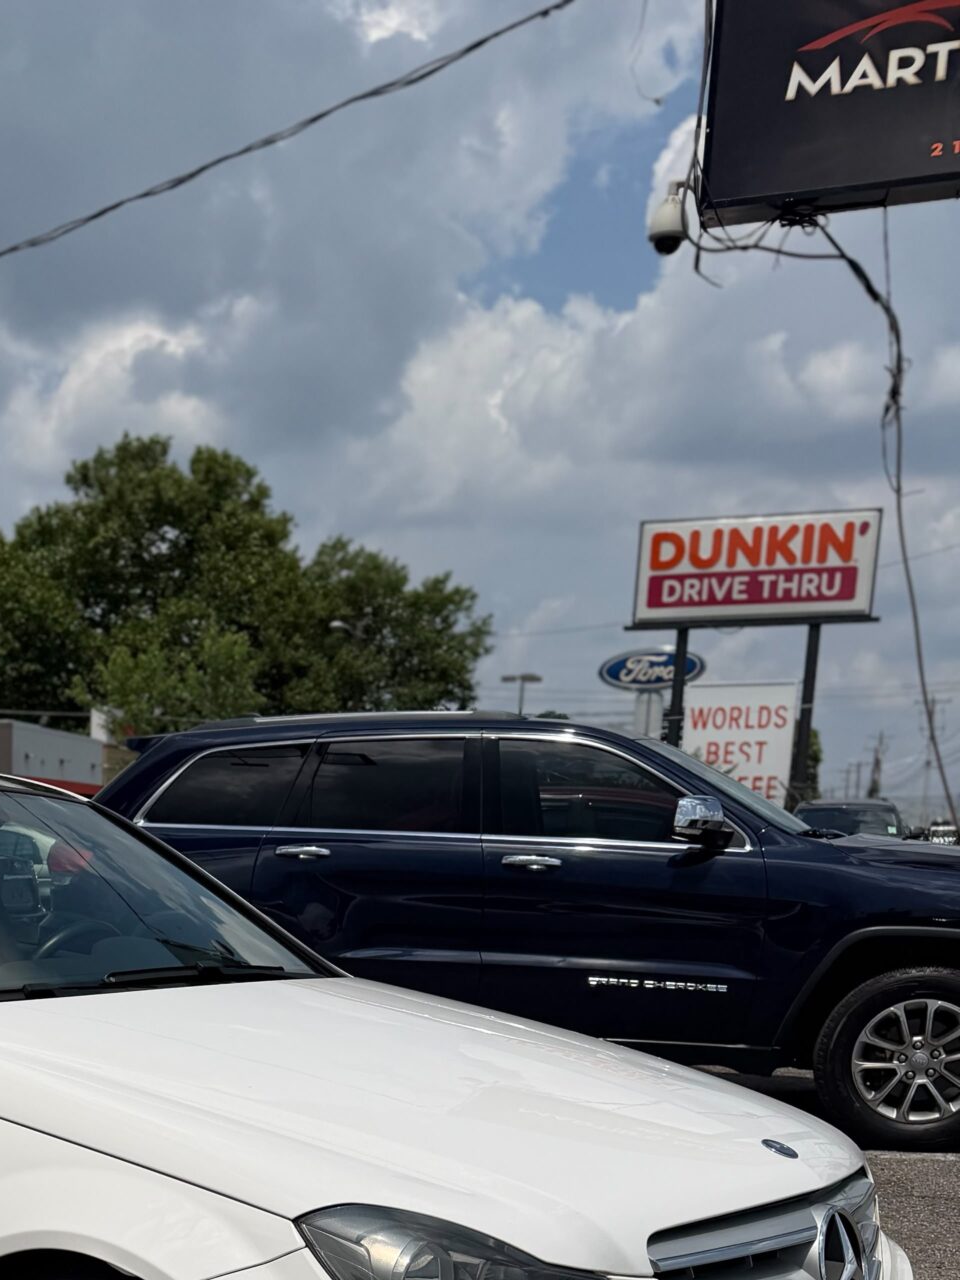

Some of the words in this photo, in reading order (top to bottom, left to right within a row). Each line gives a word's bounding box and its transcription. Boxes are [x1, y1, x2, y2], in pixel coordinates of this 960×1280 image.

[784, 39, 960, 102] MART
[649, 521, 870, 571] DUNKIN'
[661, 575, 750, 603] DRIVE
[758, 572, 843, 599] THRU
[690, 704, 789, 731] WORLDS
[704, 740, 769, 766] BEST
